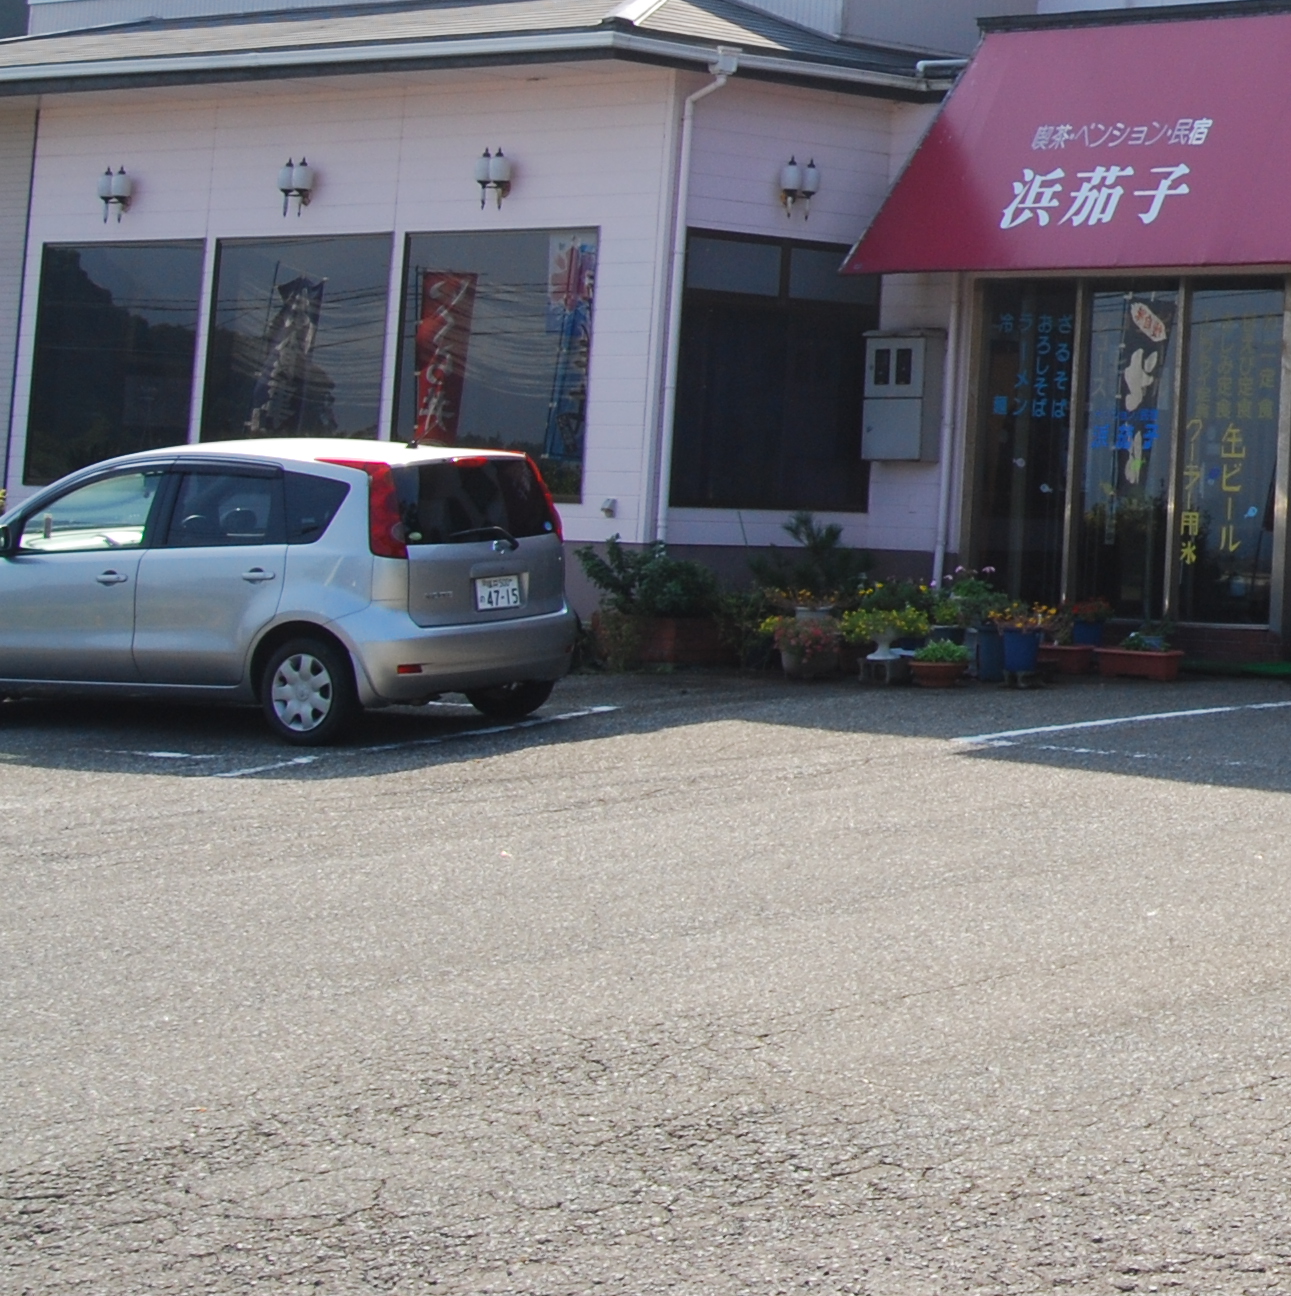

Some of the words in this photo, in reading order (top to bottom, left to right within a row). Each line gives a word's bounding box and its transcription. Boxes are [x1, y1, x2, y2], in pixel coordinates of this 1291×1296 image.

[1000, 163, 1191, 230] 浜茄子
[1013, 313, 1033, 416] ラーメン
[1032, 315, 1053, 418] おろしそば
[1052, 314, 1073, 418] ざるそば
[1220, 423, 1246, 552] 缶ビール
[487, 588, 519, 607] 47-15
